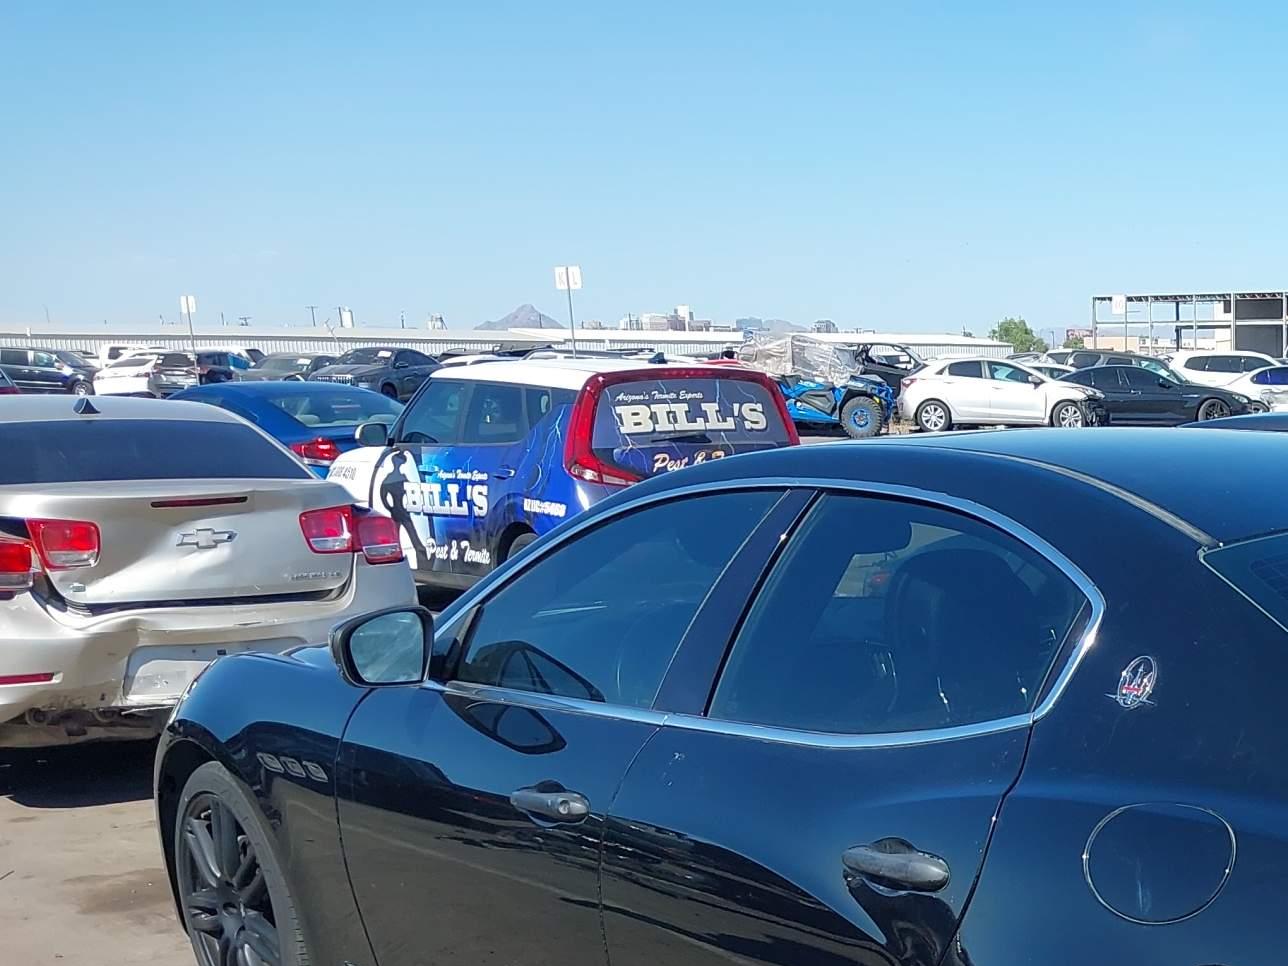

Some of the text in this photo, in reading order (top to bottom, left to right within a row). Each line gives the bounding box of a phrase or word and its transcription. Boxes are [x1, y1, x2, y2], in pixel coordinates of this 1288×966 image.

[615, 390, 704, 403] Arizona's Termite Experts
[614, 402, 767, 434] BILL'S
[652, 453, 689, 472] Pest
[403, 482, 489, 517] BILL'S
[425, 537, 491, 565] Pest & Termite
